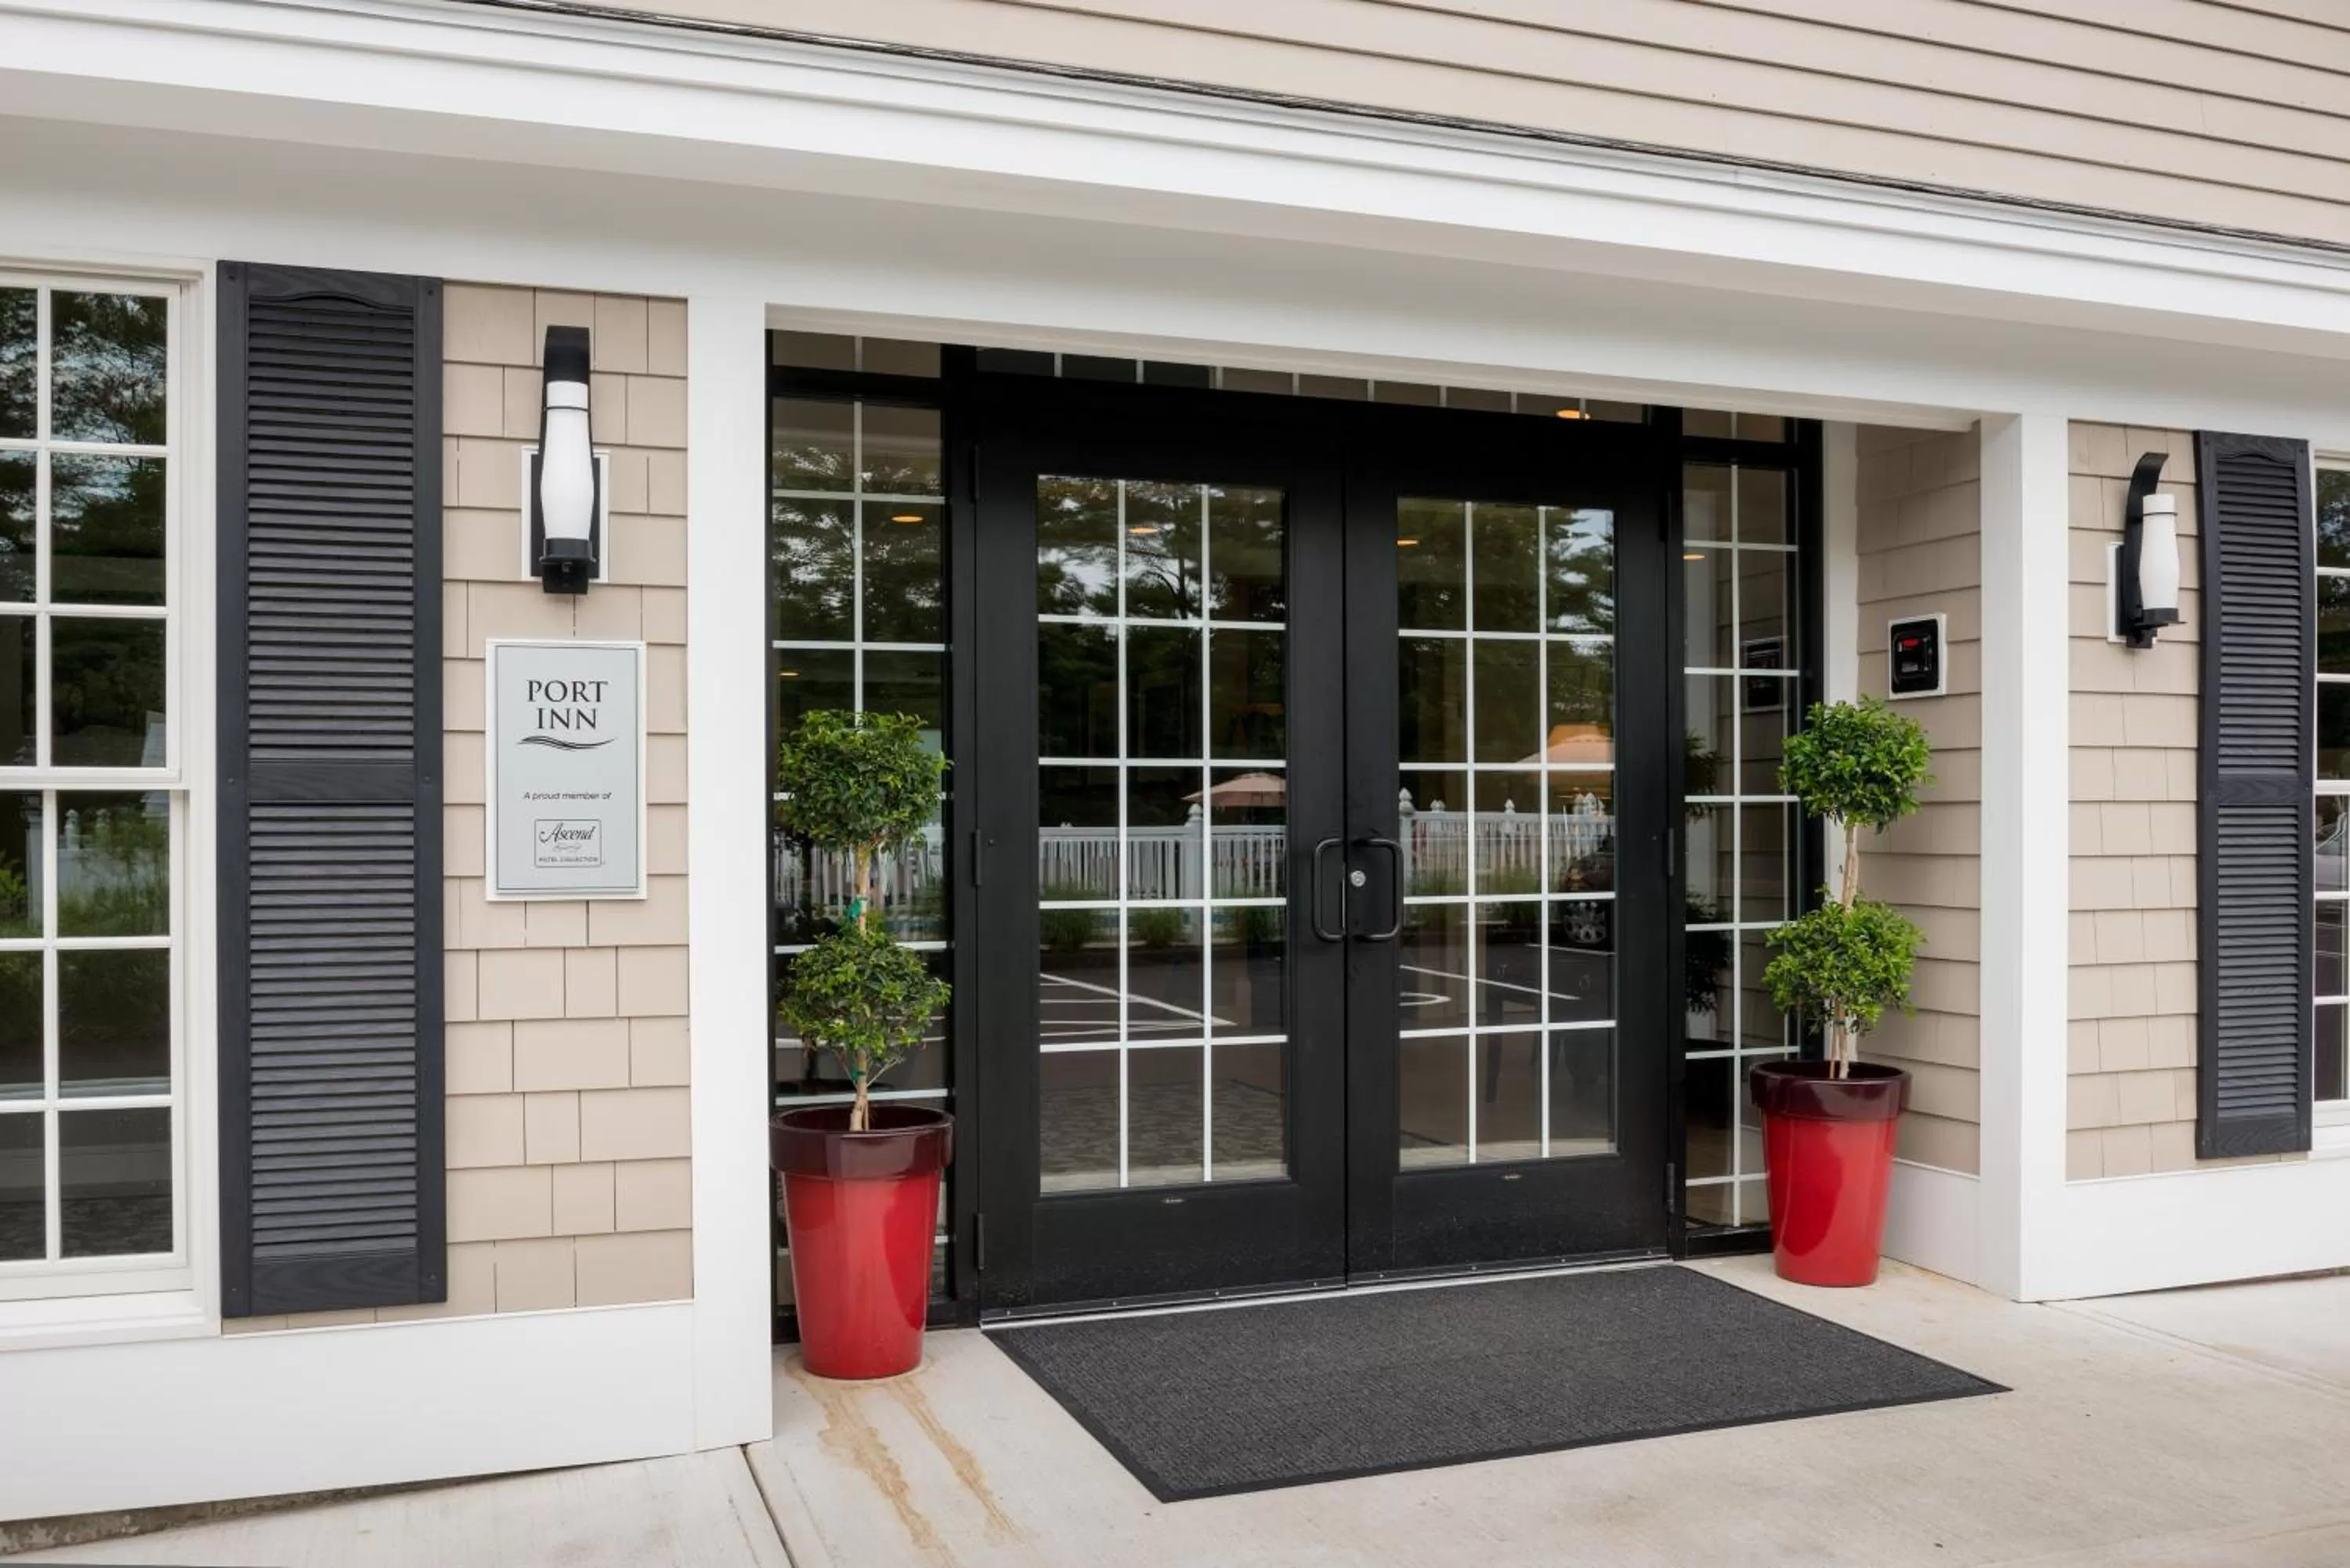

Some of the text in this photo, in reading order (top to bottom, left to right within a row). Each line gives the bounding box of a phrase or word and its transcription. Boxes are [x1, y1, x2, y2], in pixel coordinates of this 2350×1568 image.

[526, 679, 609, 703] PORT
[537, 707, 598, 729] INN
[532, 792, 560, 800] proud
[538, 822, 596, 844] Ascend
